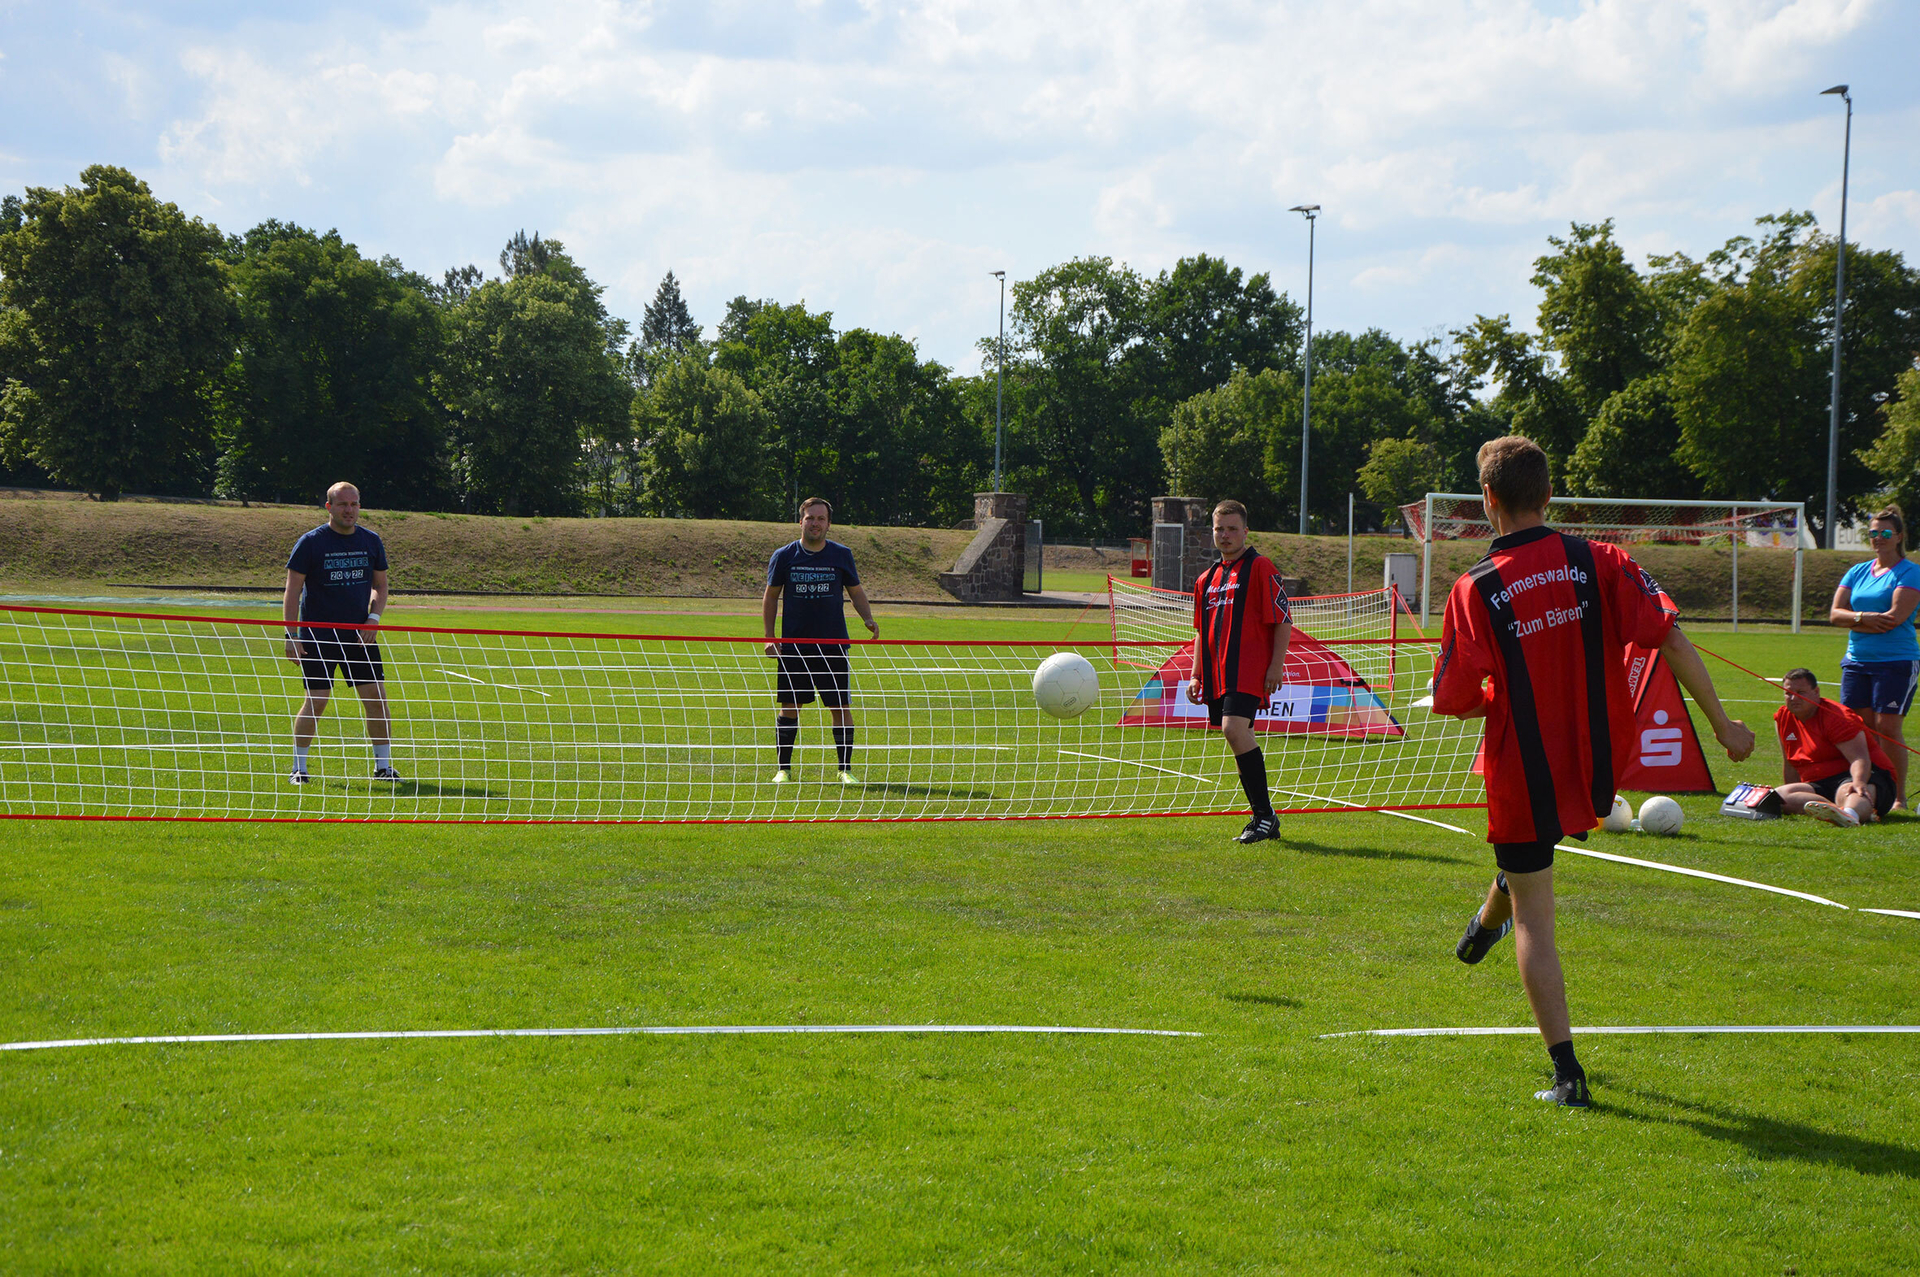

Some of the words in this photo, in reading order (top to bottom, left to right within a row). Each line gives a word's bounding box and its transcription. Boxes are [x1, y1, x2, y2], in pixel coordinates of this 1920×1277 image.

[324, 557, 369, 569] MEISTER
[331, 571, 343, 580] 20
[352, 570, 363, 578] 22
[791, 573, 835, 582] MEISTER
[796, 584, 807, 593] 20
[818, 583, 829, 592] 22
[1490, 565, 1587, 610] Fermerswalde
